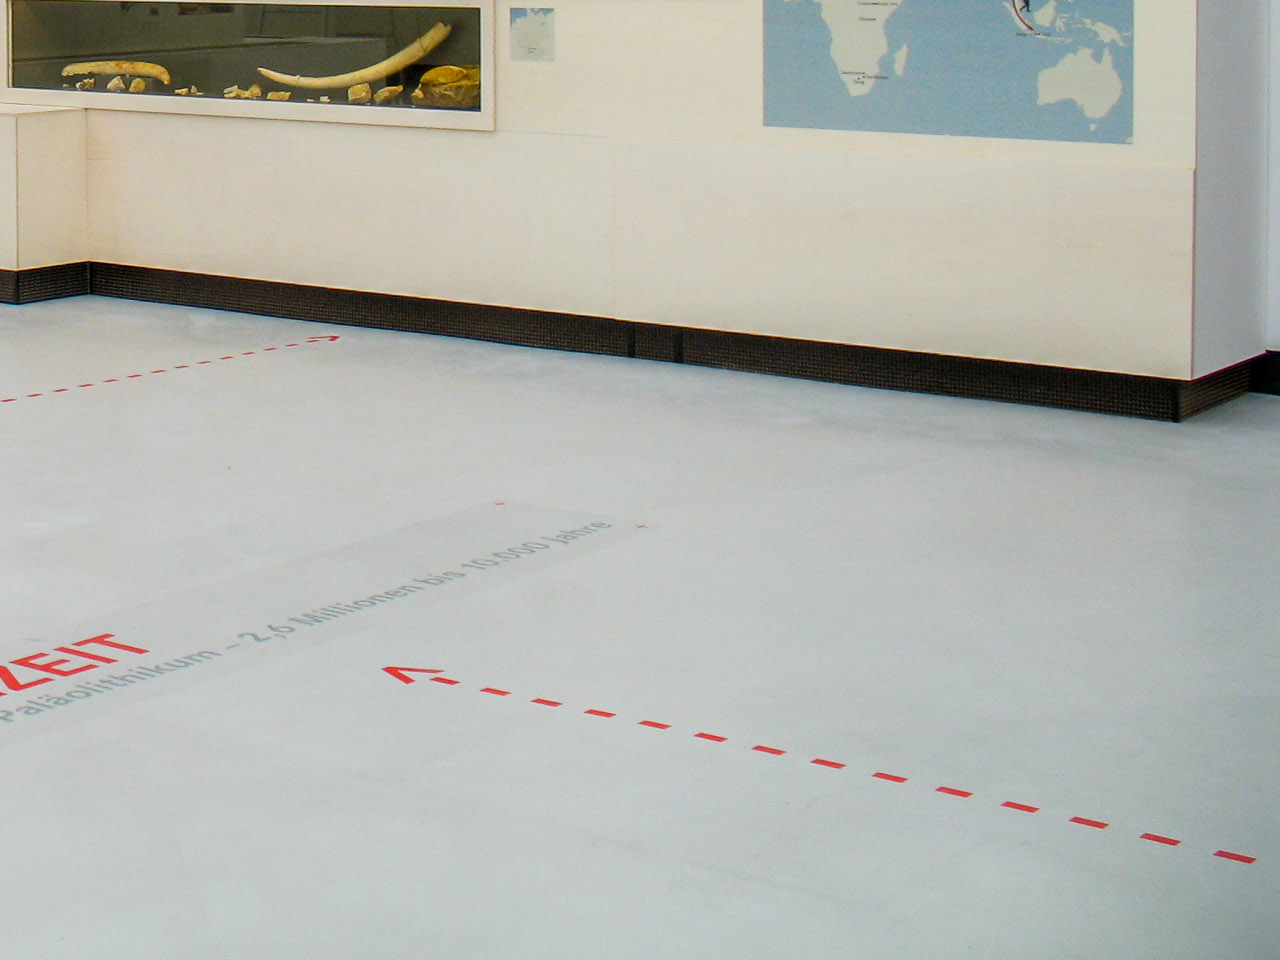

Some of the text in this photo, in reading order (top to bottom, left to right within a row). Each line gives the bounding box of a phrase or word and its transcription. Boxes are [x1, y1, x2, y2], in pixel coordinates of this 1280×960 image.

[236, 622, 296, 646] 2,6
[289, 582, 424, 628] Millionen
[413, 568, 467, 588] bis
[461, 541, 551, 571] 10.000
[540, 521, 612, 544] Jahre
